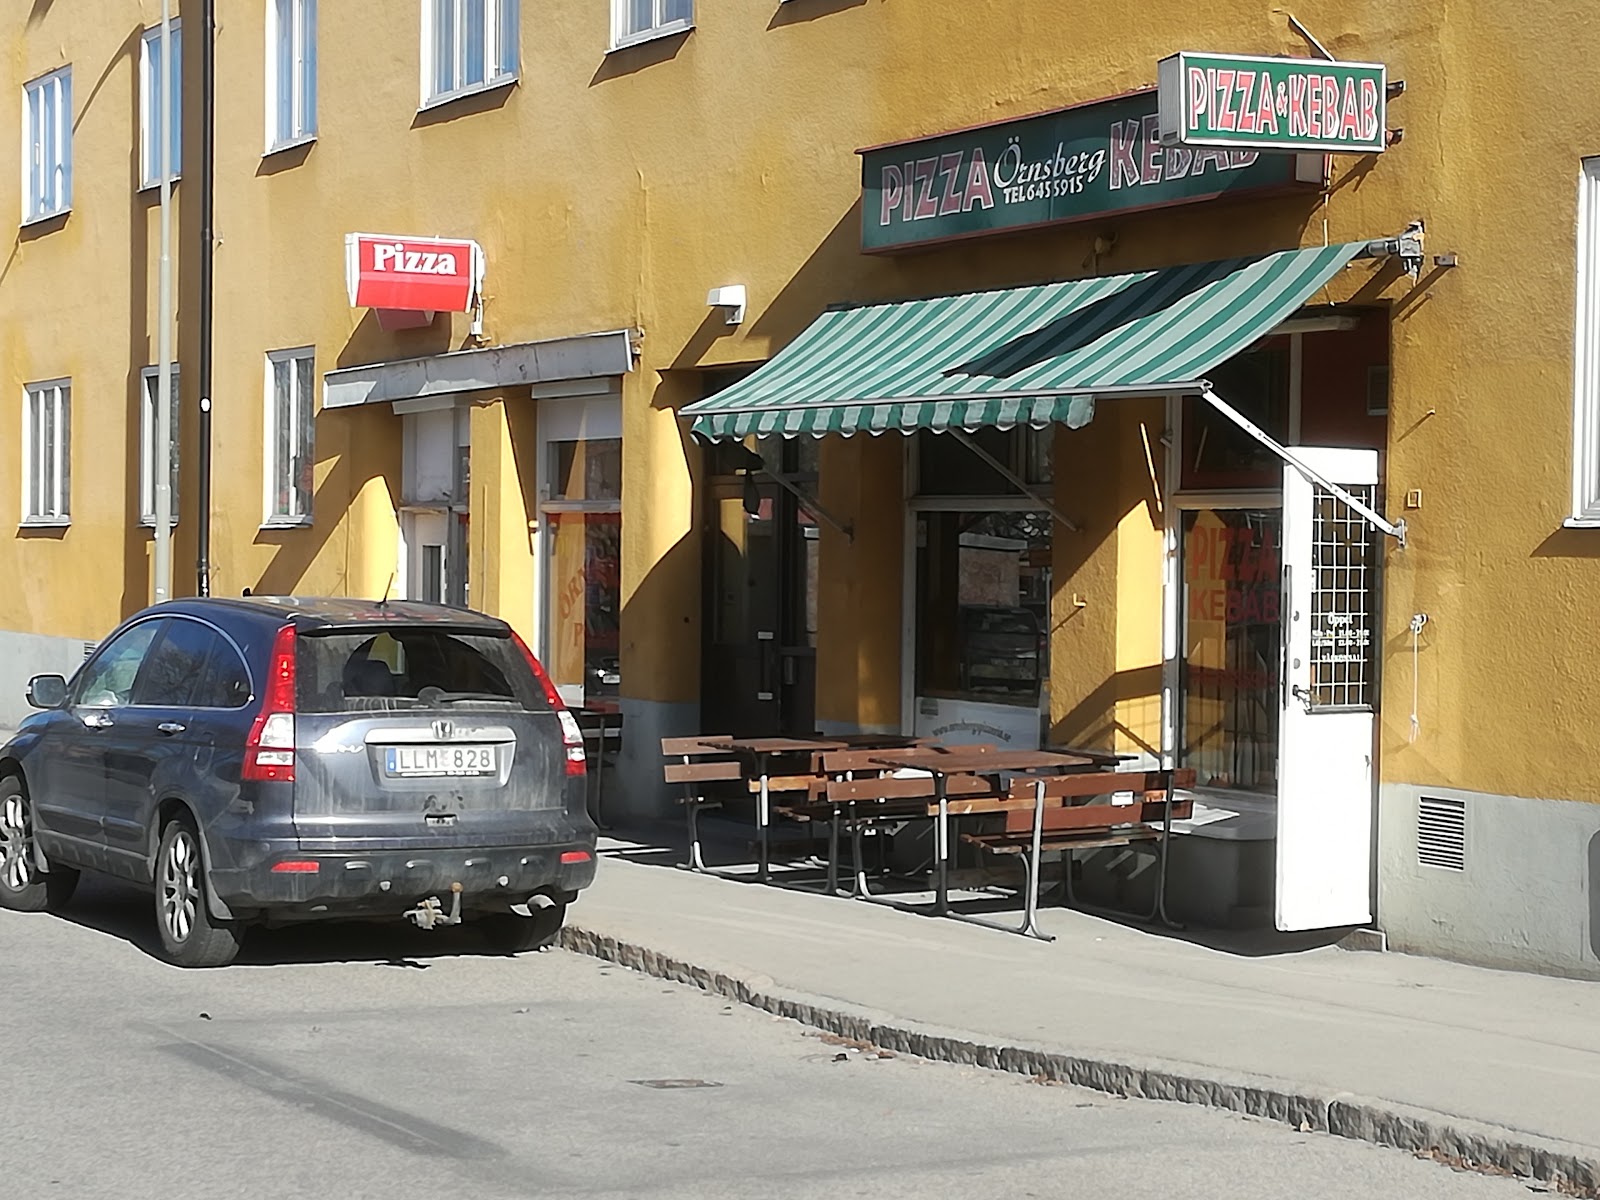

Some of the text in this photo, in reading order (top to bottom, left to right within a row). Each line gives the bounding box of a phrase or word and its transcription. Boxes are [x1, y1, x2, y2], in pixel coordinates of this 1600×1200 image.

[880, 147, 995, 226] PIZZA
[993, 136, 1106, 188] Örnsberg
[373, 243, 457, 275] Pizza
[1191, 526, 1277, 582] PIZZA
[1190, 589, 1279, 623] KEBAB
[400, 750, 438, 769] LLM
[453, 750, 490, 768] 828
